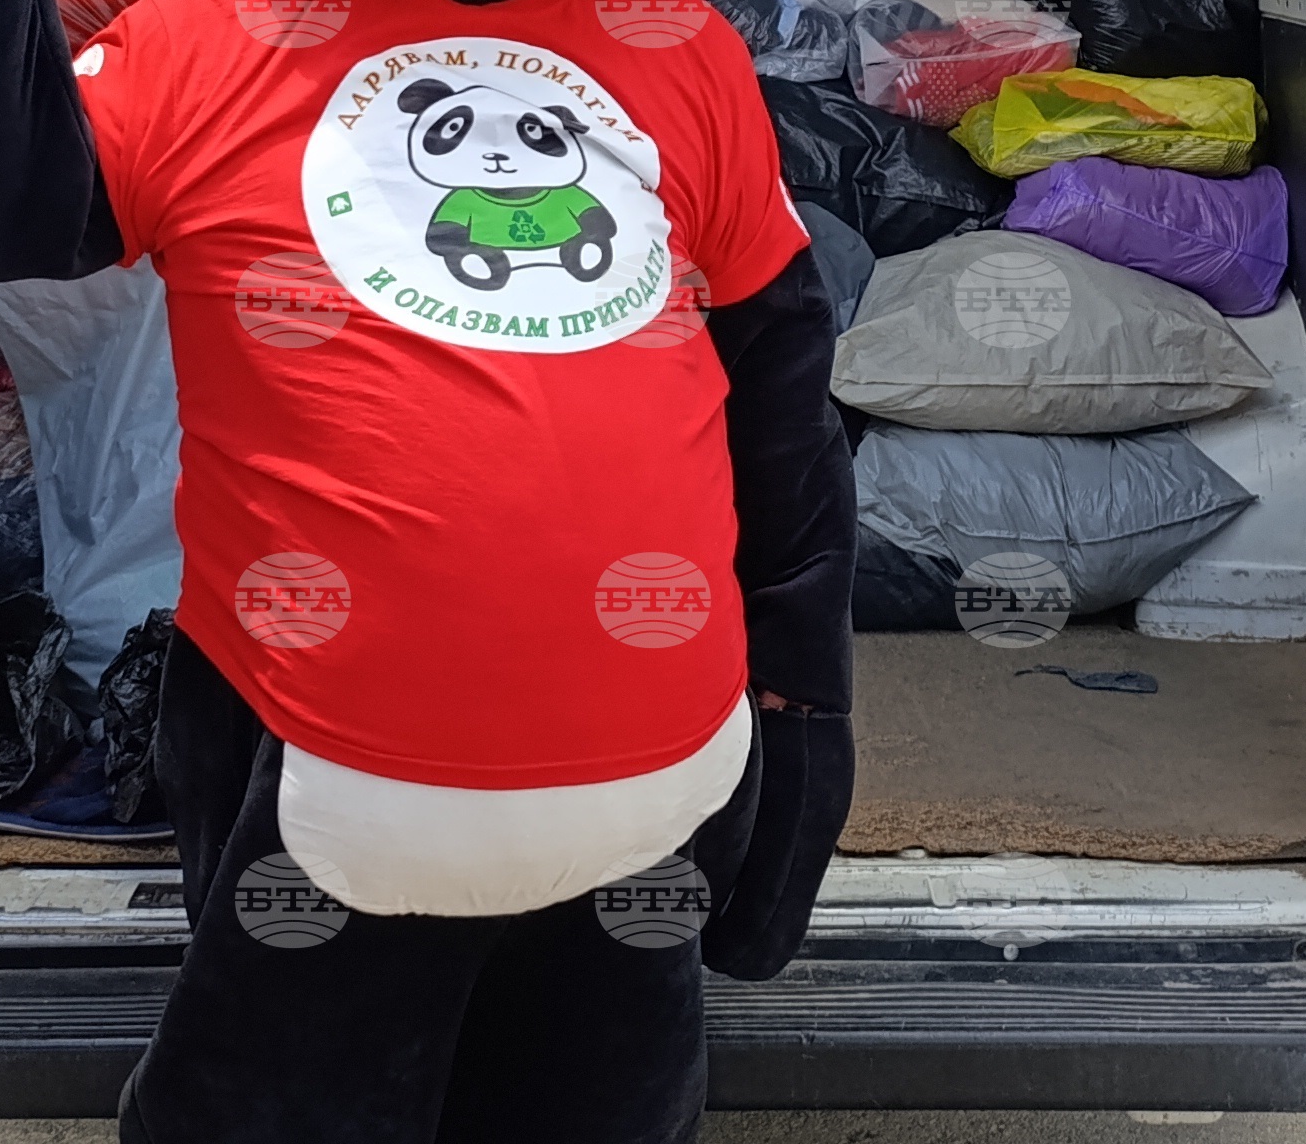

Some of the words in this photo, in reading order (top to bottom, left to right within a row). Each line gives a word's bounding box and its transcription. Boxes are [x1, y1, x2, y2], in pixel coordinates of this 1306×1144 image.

[494, 50, 644, 143] ПОМАГАМ
[363, 266, 397, 294] И
[394, 287, 550, 338] ОПАЗВАМ
[558, 238, 665, 338] ПРИРОДАТА
